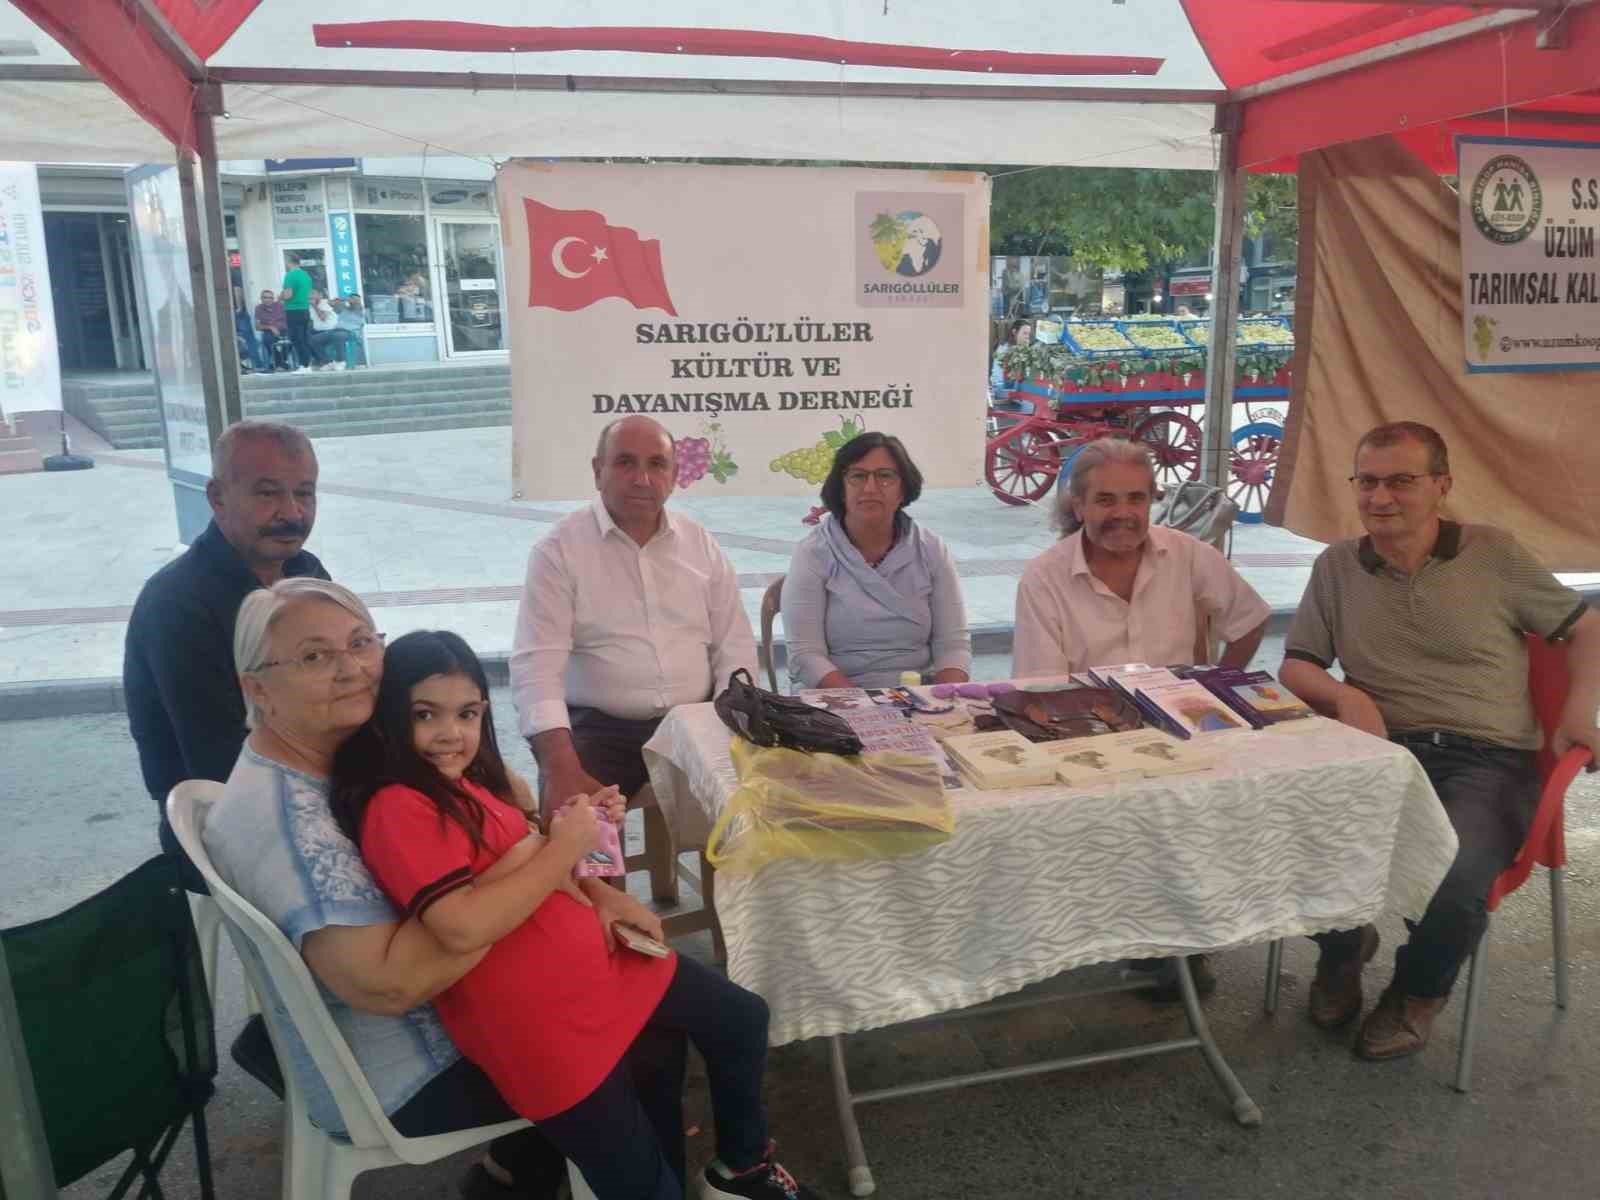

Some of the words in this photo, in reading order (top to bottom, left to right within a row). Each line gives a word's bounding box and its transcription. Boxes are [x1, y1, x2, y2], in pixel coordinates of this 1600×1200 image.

[1544, 218, 1594, 258] ÜZÜM
[863, 281, 960, 294] SARIGÖLLÜLER
[1469, 272, 1560, 304] TARIMSAL
[1566, 272, 1600, 304] KAL
[671, 352, 794, 379] KÜLTÜR
[802, 357, 841, 378] VE
[592, 393, 770, 418] DAYANIŞMA
[780, 383, 914, 410] DERNEĞİ
